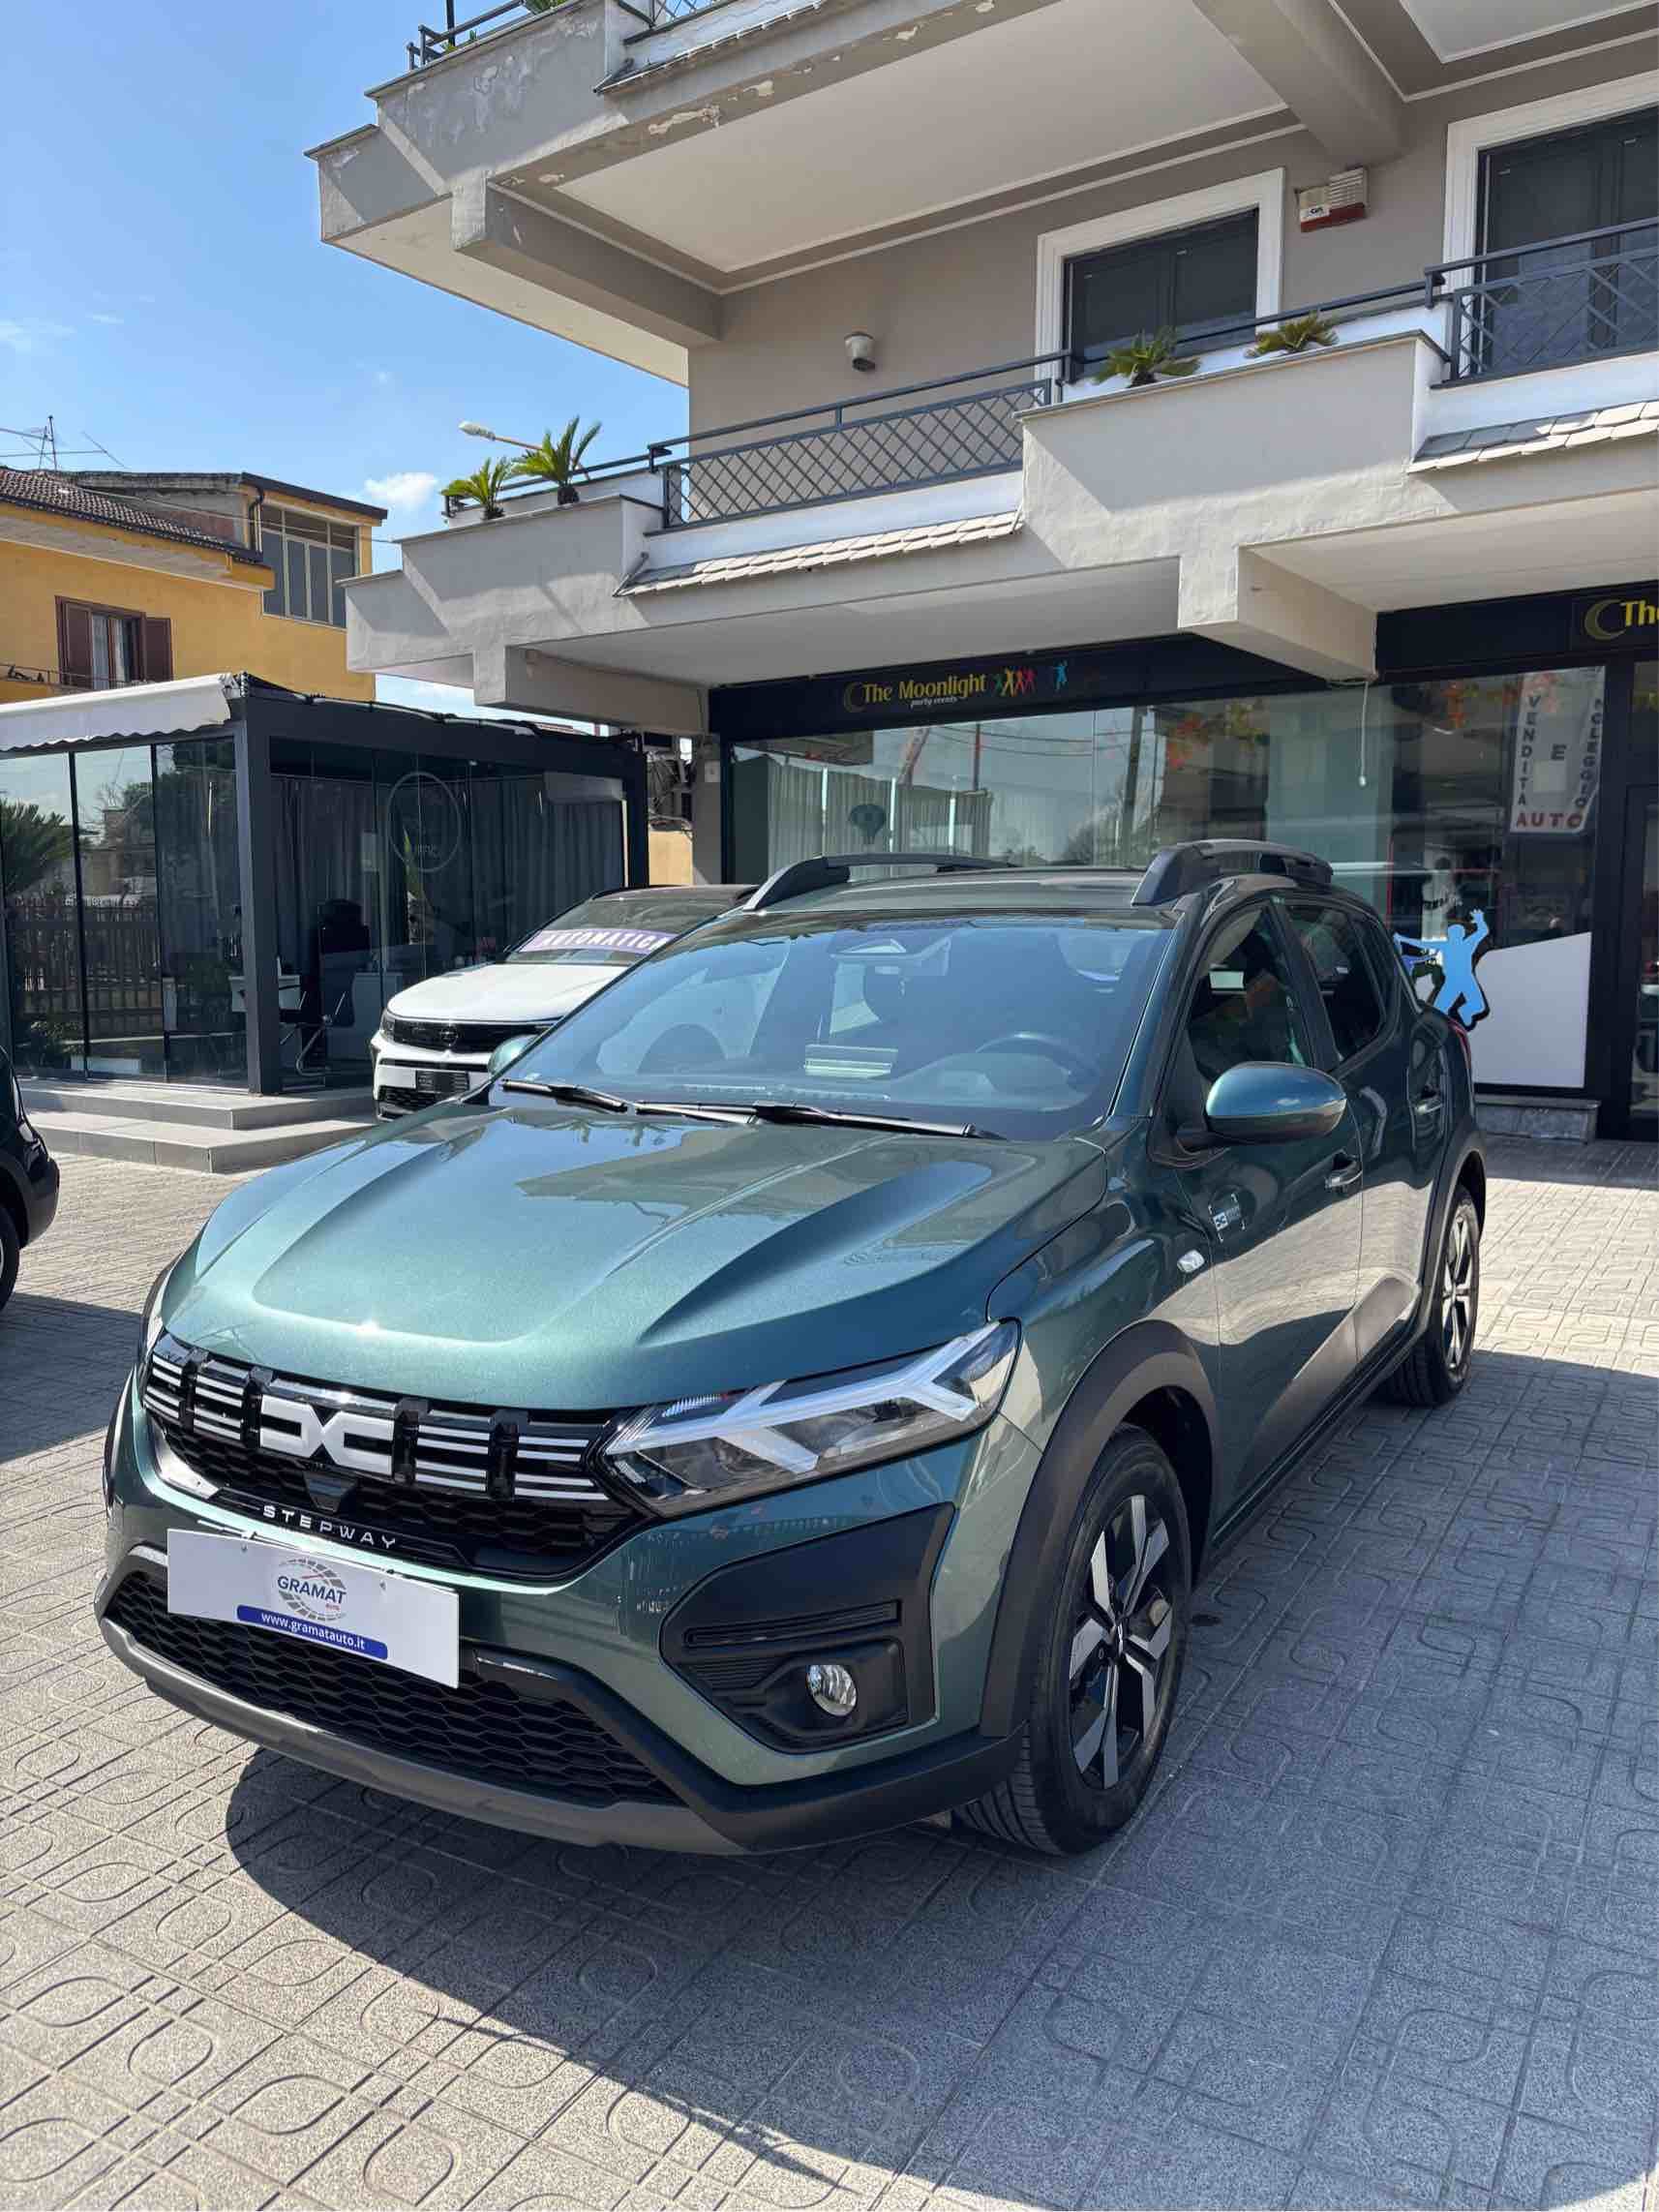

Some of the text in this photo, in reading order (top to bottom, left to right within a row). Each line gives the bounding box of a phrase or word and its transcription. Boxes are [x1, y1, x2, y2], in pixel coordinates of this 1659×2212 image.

[863, 674, 986, 703] The Moonlight
[1517, 695, 1541, 806] VENDITA
[1550, 743, 1567, 761] E
[1516, 812, 1584, 829] AUTO
[262, 1504, 396, 1550] STEPWAY
[277, 1575, 347, 1605] GRAMAT
[260, 1612, 367, 1651] www.gramatauto.it
